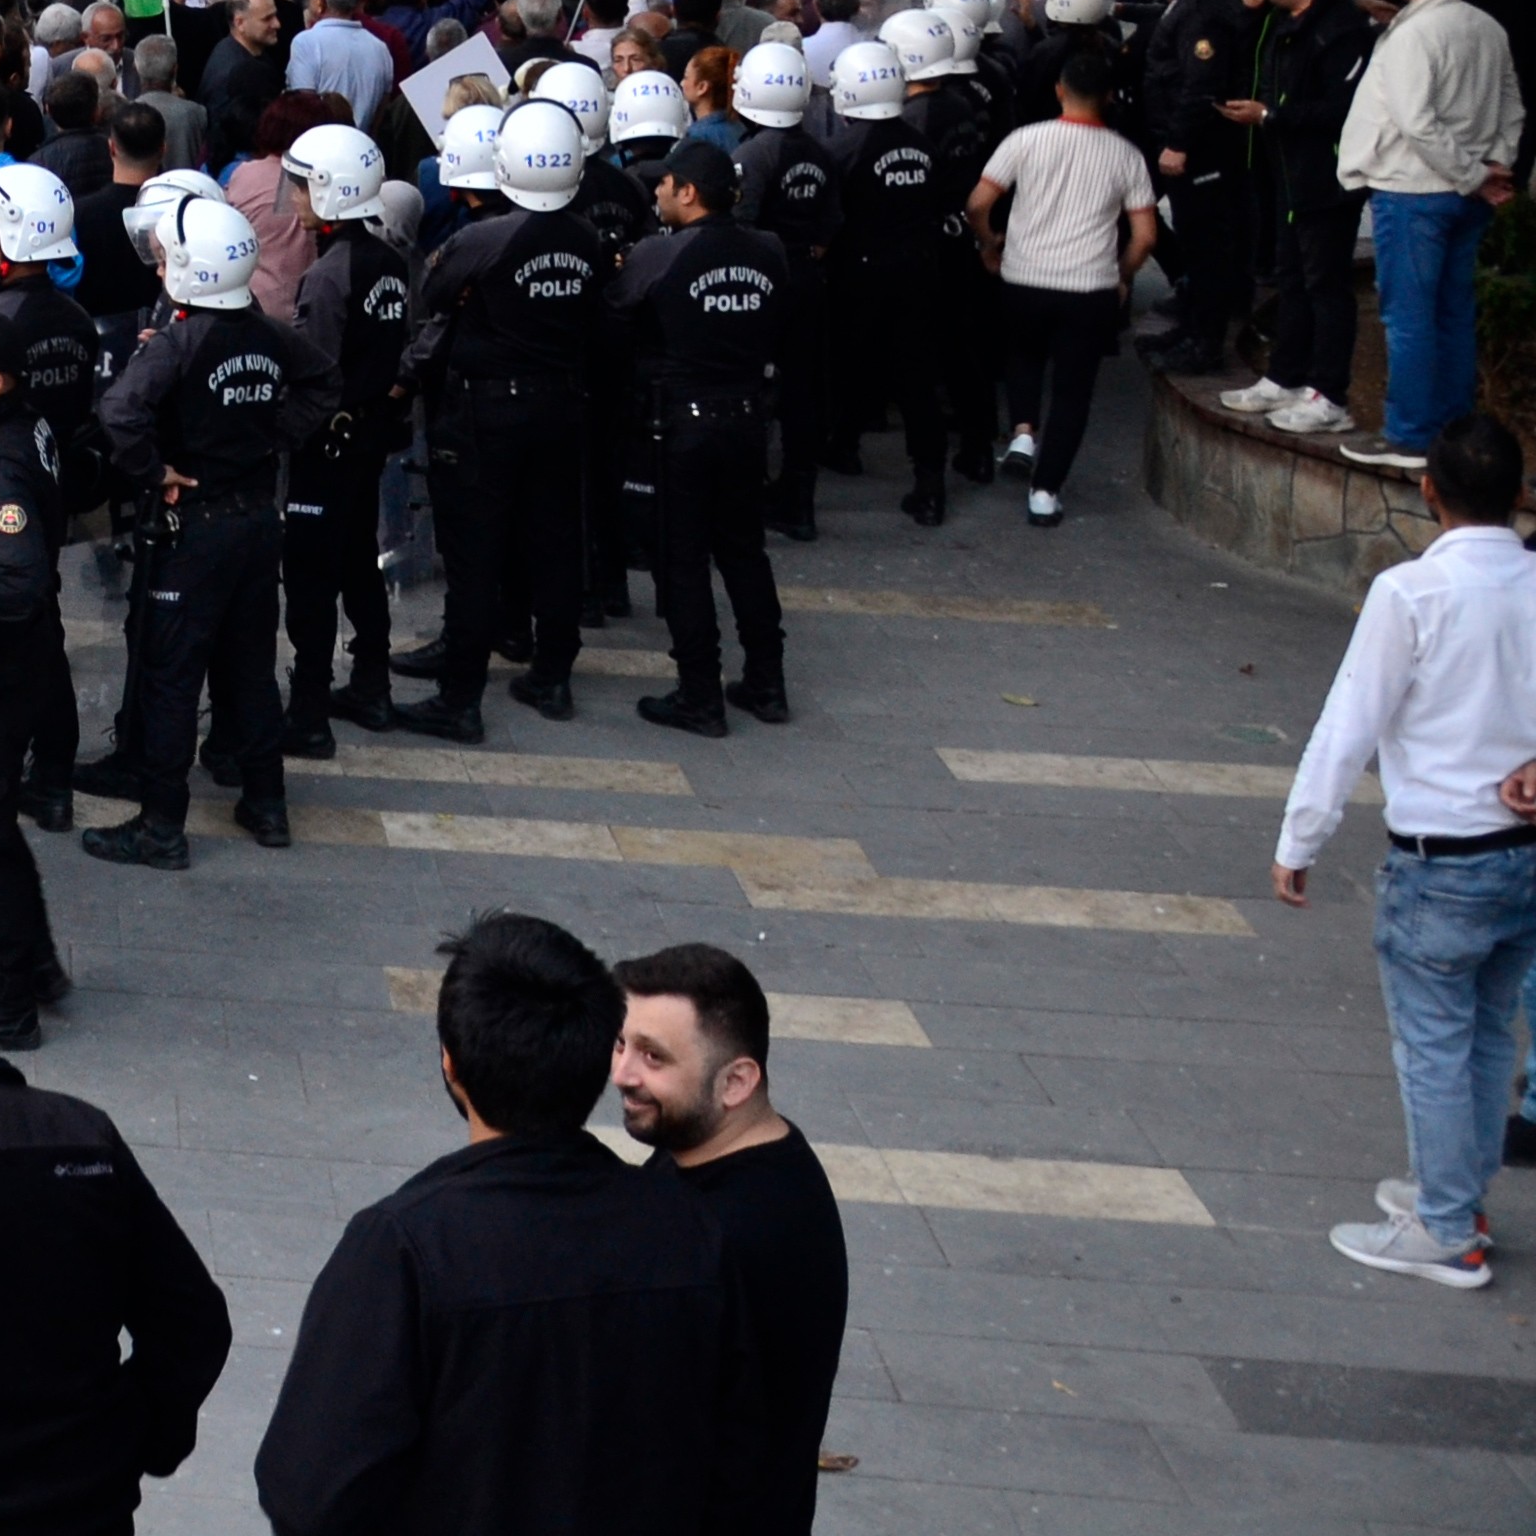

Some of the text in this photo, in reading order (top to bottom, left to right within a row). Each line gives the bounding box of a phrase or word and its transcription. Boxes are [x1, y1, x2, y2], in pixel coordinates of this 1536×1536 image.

[764, 72, 804, 88] 2414
[858, 67, 897, 84] 2121
[524, 151, 572, 170] 1322
[341, 184, 361, 198] 01
[36, 220, 56, 235] 01
[198, 270, 219, 285] 01
[729, 266, 774, 297] KUVVET
[703, 292, 762, 313] POLİS
[222, 382, 274, 407] POLİS
